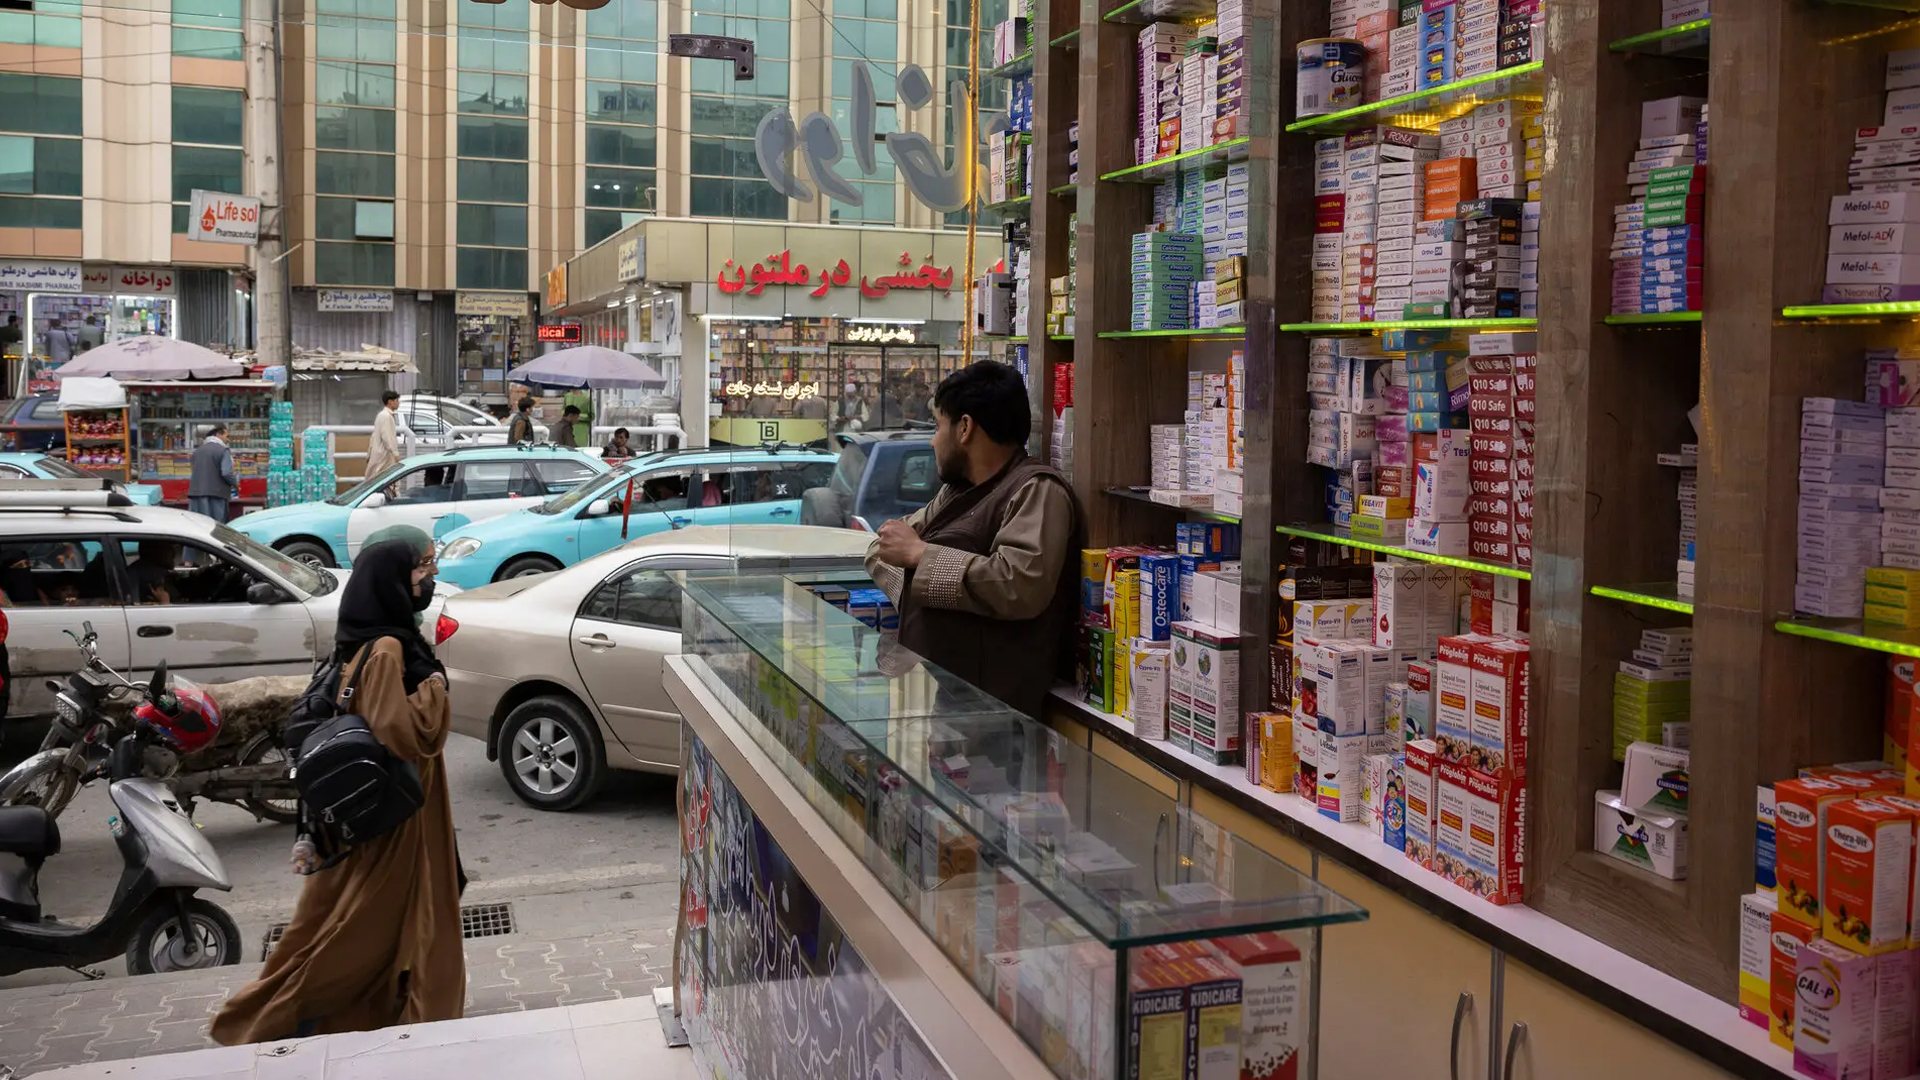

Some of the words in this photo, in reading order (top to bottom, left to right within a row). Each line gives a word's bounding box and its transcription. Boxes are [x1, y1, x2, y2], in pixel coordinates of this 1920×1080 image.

[217, 200, 238, 220] Life
[240, 204, 258, 222] sol
[1843, 202, 1889, 212] Mefol-AD
[216, 228, 256, 239] Pharmaceutical
[1841, 262, 1884, 272] Mefol-A
[44, 282, 81, 290] PHARMACY
[1488, 400, 1506, 411] Safe
[1361, 499, 1384, 508] VEGAVIT
[1155, 566, 1166, 626] Osteocare
[1440, 646, 1468, 661] Proglobin
[1473, 654, 1503, 670] Proglobin
[1406, 752, 1429, 768] Proglobin
[1440, 764, 1466, 782] Proglobin
[1468, 777, 1498, 796] Proglobin
[1779, 805, 1810, 822] Thera-Vit
[1834, 828, 1868, 848] Thera-Vit
[1798, 976, 1834, 999] CAL-P
[1132, 996, 1184, 1014] KIDICARE
[1190, 988, 1240, 1006] KIDICARE
